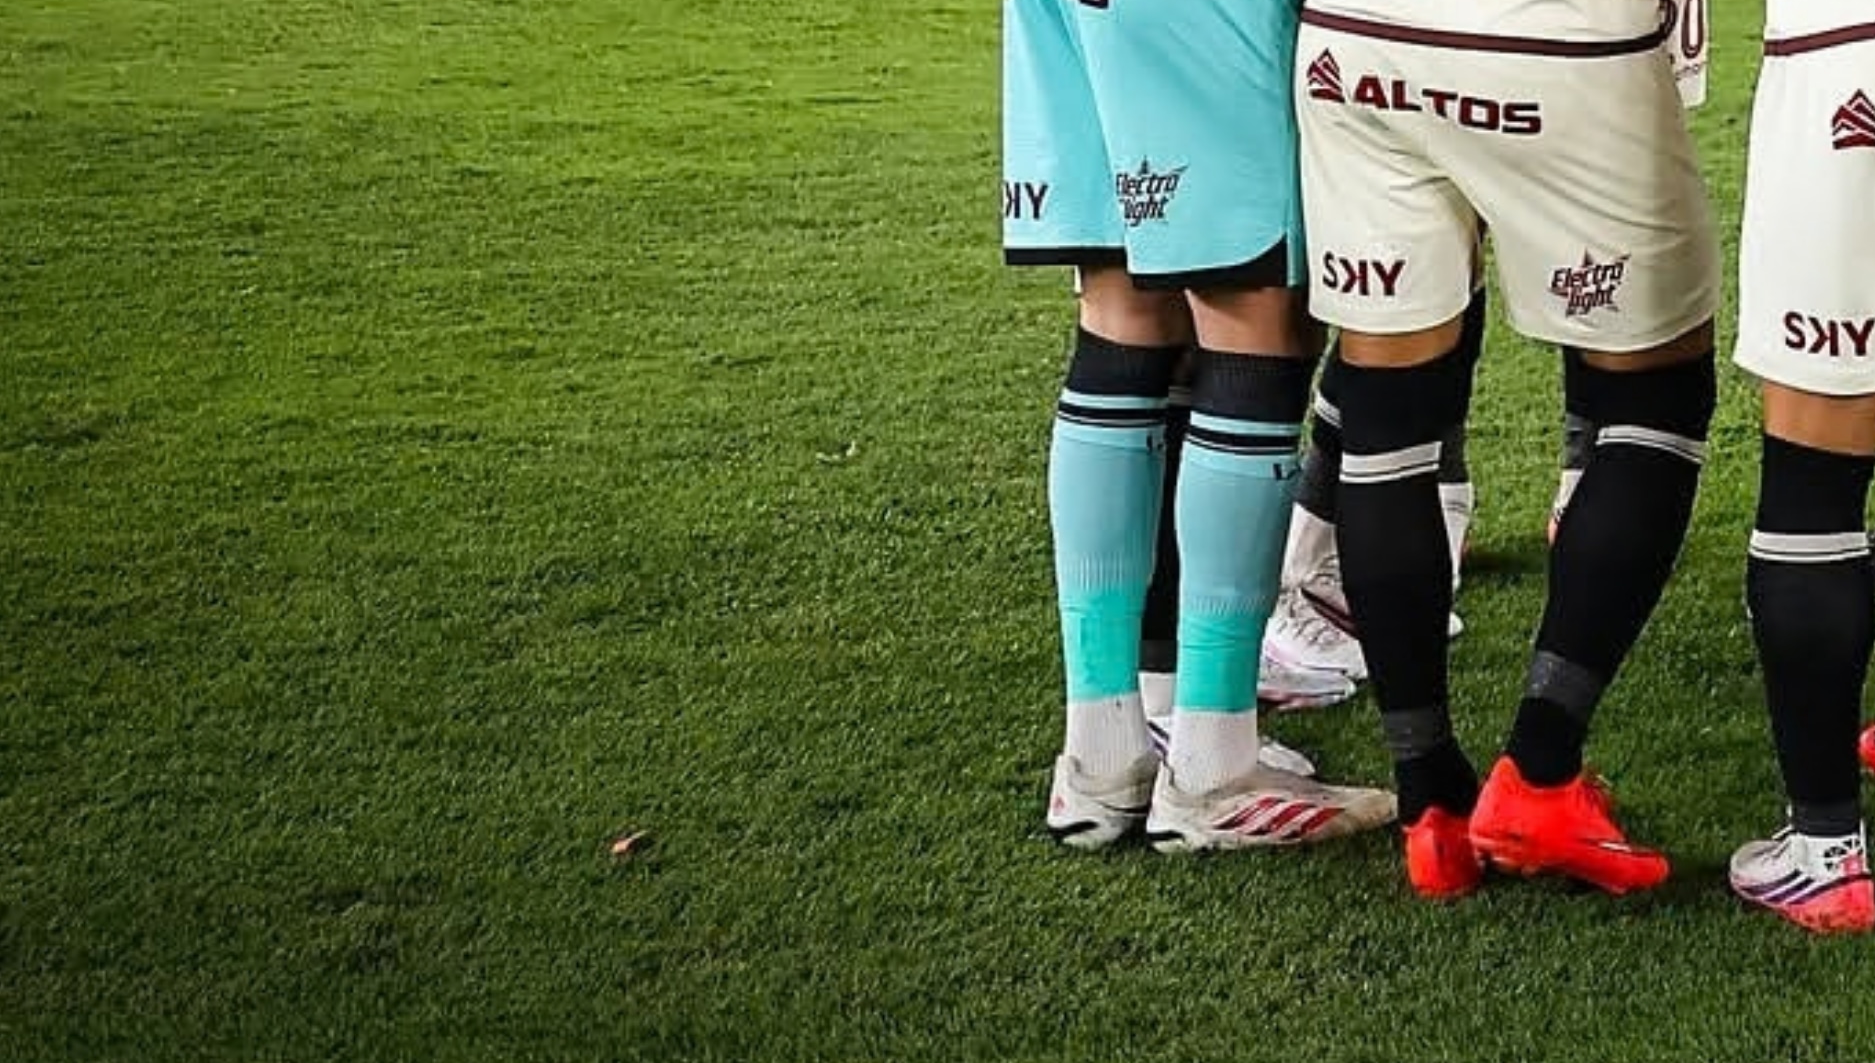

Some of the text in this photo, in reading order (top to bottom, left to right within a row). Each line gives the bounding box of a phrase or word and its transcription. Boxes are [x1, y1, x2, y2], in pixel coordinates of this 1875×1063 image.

[1354, 75, 1543, 136] ALTOS
[1323, 252, 1406, 297] SKY
[1551, 262, 1624, 289] Electro
